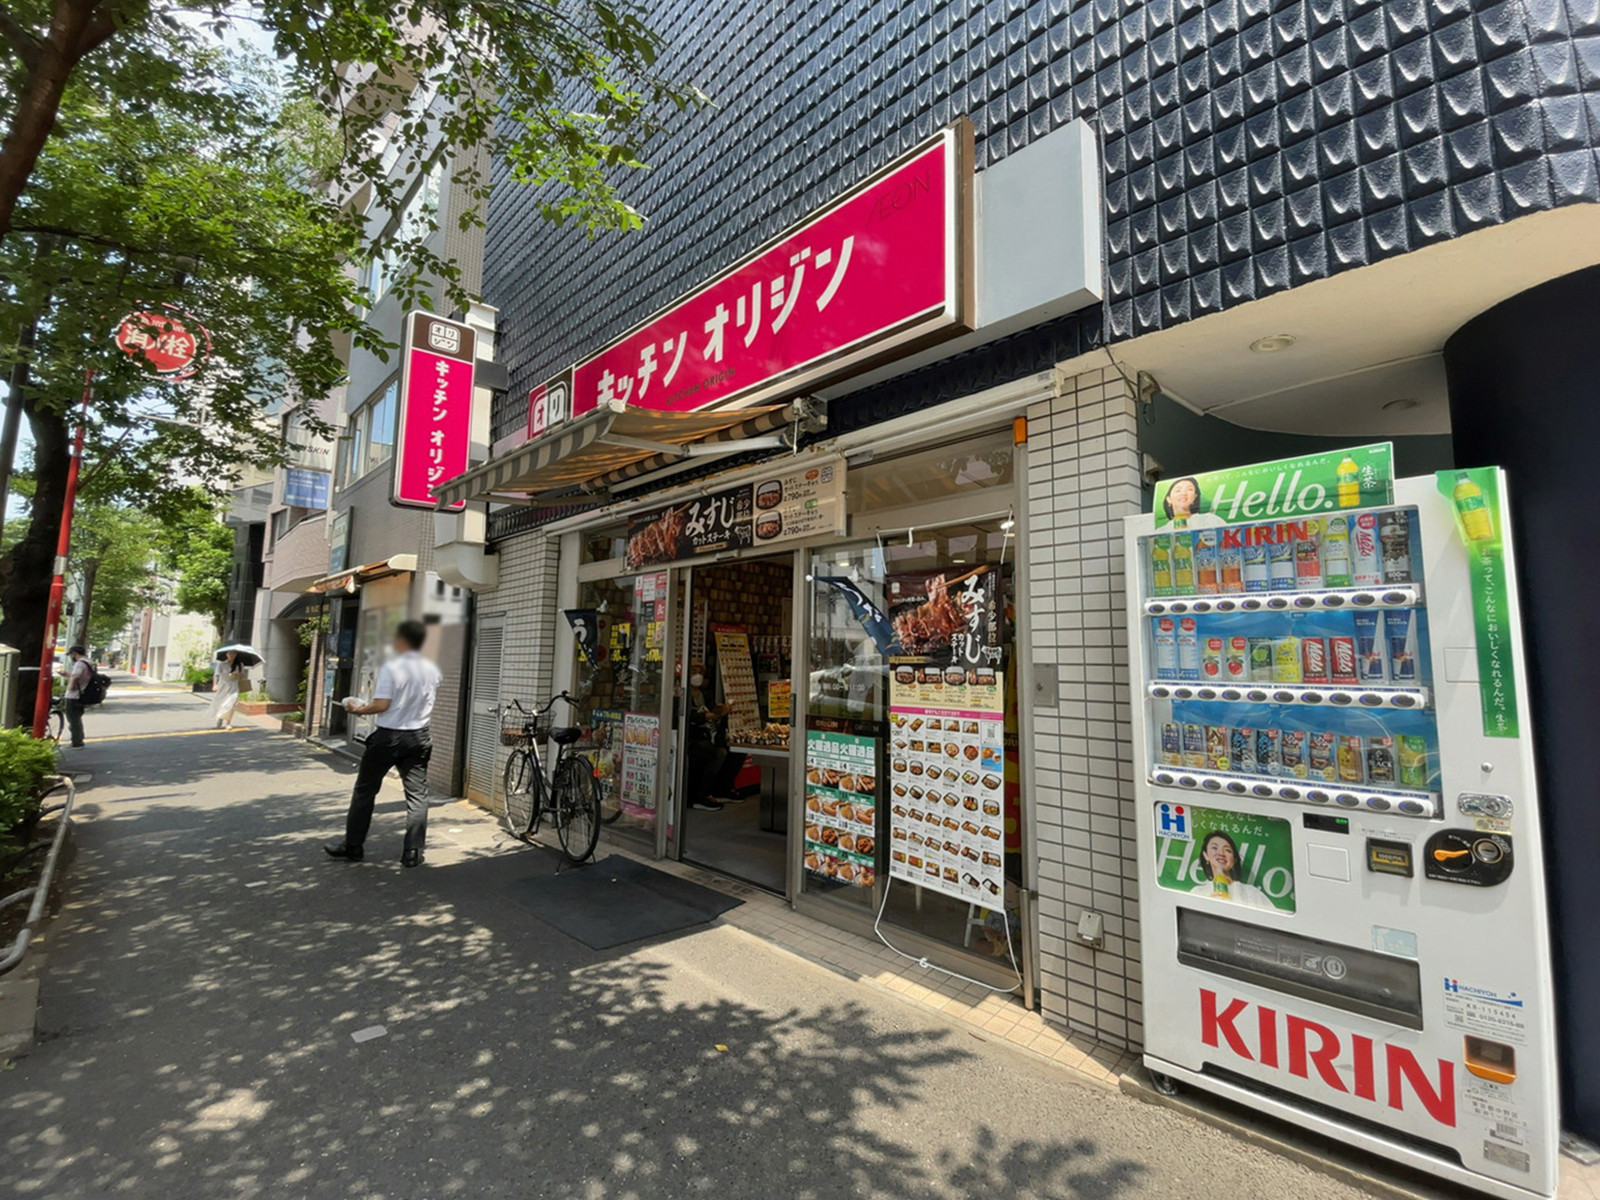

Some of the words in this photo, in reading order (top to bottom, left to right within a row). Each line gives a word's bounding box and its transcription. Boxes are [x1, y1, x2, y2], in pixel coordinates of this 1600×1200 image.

[596, 331, 688, 406] キッチン
[703, 235, 854, 364] オリジン
[432, 360, 450, 421] キッチン
[665, 382, 701, 406] KITCHEN
[703, 367, 737, 389] ORIGIN
[1211, 468, 1334, 520] Hello.
[1362, 464, 1377, 489] 生茶
[686, 497, 734, 537] みすじ
[1222, 521, 1308, 549] KIRIN
[692, 529, 731, 546] カットステーキ
[961, 574, 985, 664] みすじ
[1306, 640, 1323, 673] Mets
[1335, 640, 1353, 673] Mets
[1199, 988, 1457, 1128] KIRIN
